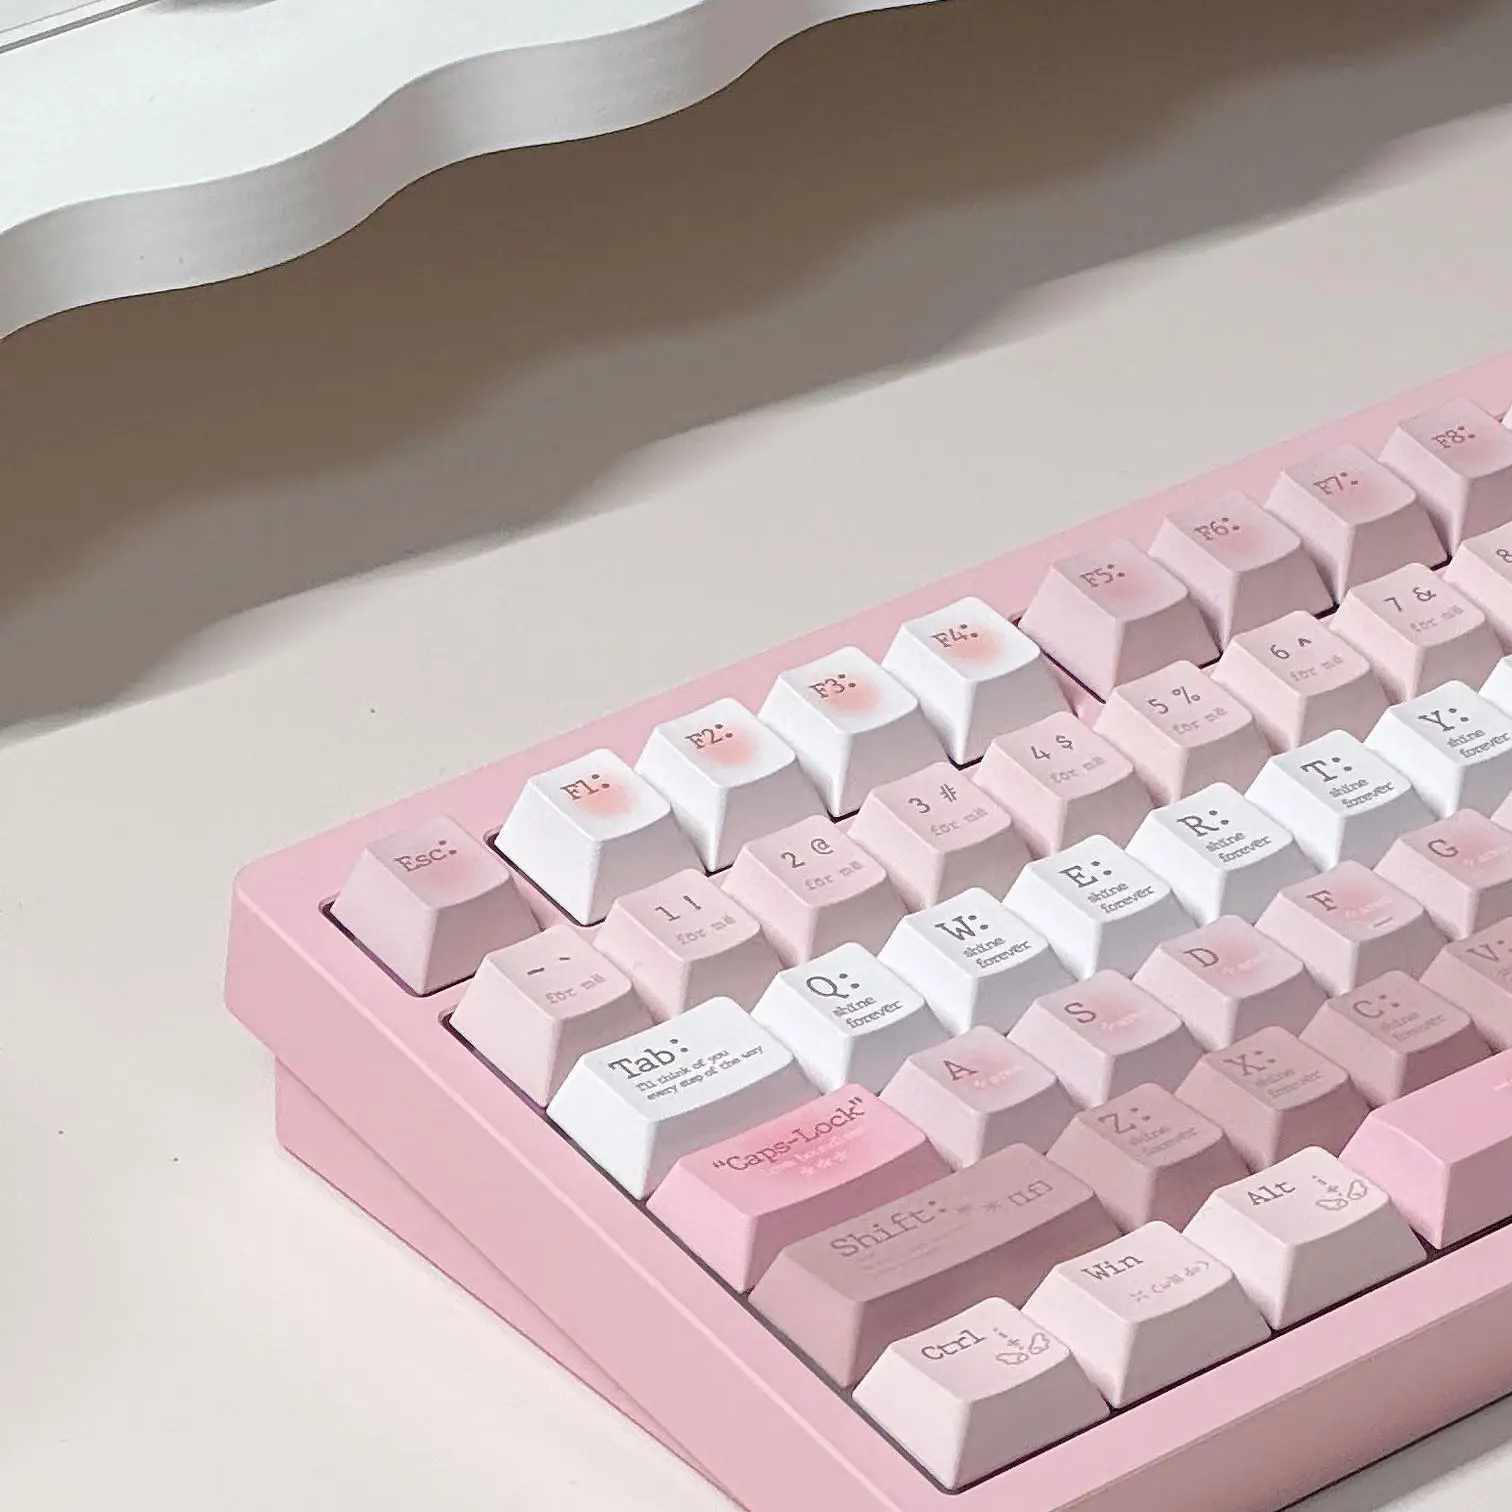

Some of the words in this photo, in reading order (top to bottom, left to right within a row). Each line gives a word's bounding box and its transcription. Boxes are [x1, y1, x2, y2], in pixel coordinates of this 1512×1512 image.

[1460, 732, 1512, 759] forever
[1342, 781, 1395, 808] forever
[1219, 834, 1272, 863] forever
[1428, 839, 1458, 858] G
[1100, 885, 1155, 914] forever
[1306, 890, 1337, 911] F
[976, 940, 1032, 969] forever
[1185, 948, 1218, 967] D
[846, 999, 903, 1030] forever
[1064, 1002, 1097, 1023] S
[609, 1039, 688, 1079] Tab:
[943, 1059, 978, 1080] A
[1247, 1180, 1296, 1207] Alt
[1081, 1253, 1144, 1282] Win
[921, 1329, 987, 1361] Ctrl
